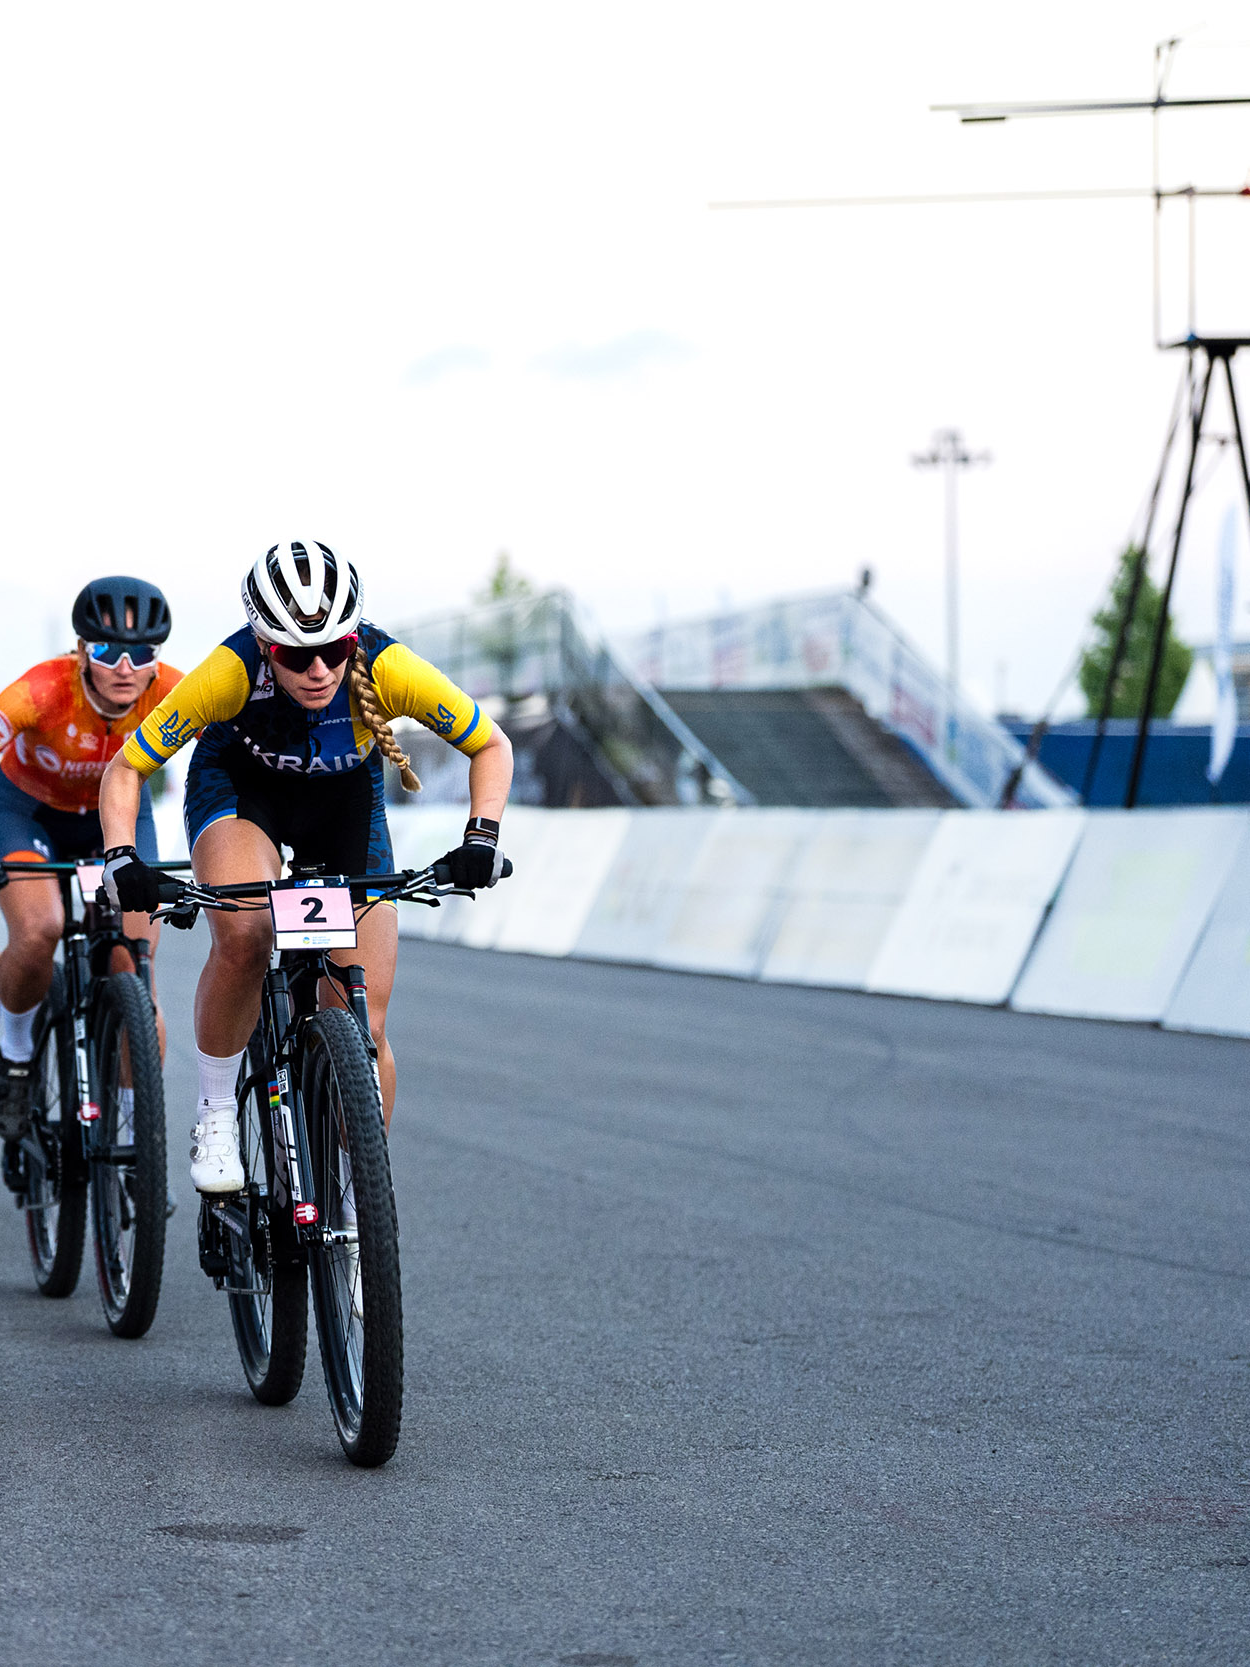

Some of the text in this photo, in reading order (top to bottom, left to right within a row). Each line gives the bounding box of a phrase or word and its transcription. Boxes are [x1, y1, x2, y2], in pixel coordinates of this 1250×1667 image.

[242, 591, 259, 621] GIRO
[244, 734, 377, 774] KRAIN
[301, 897, 327, 923] 2
